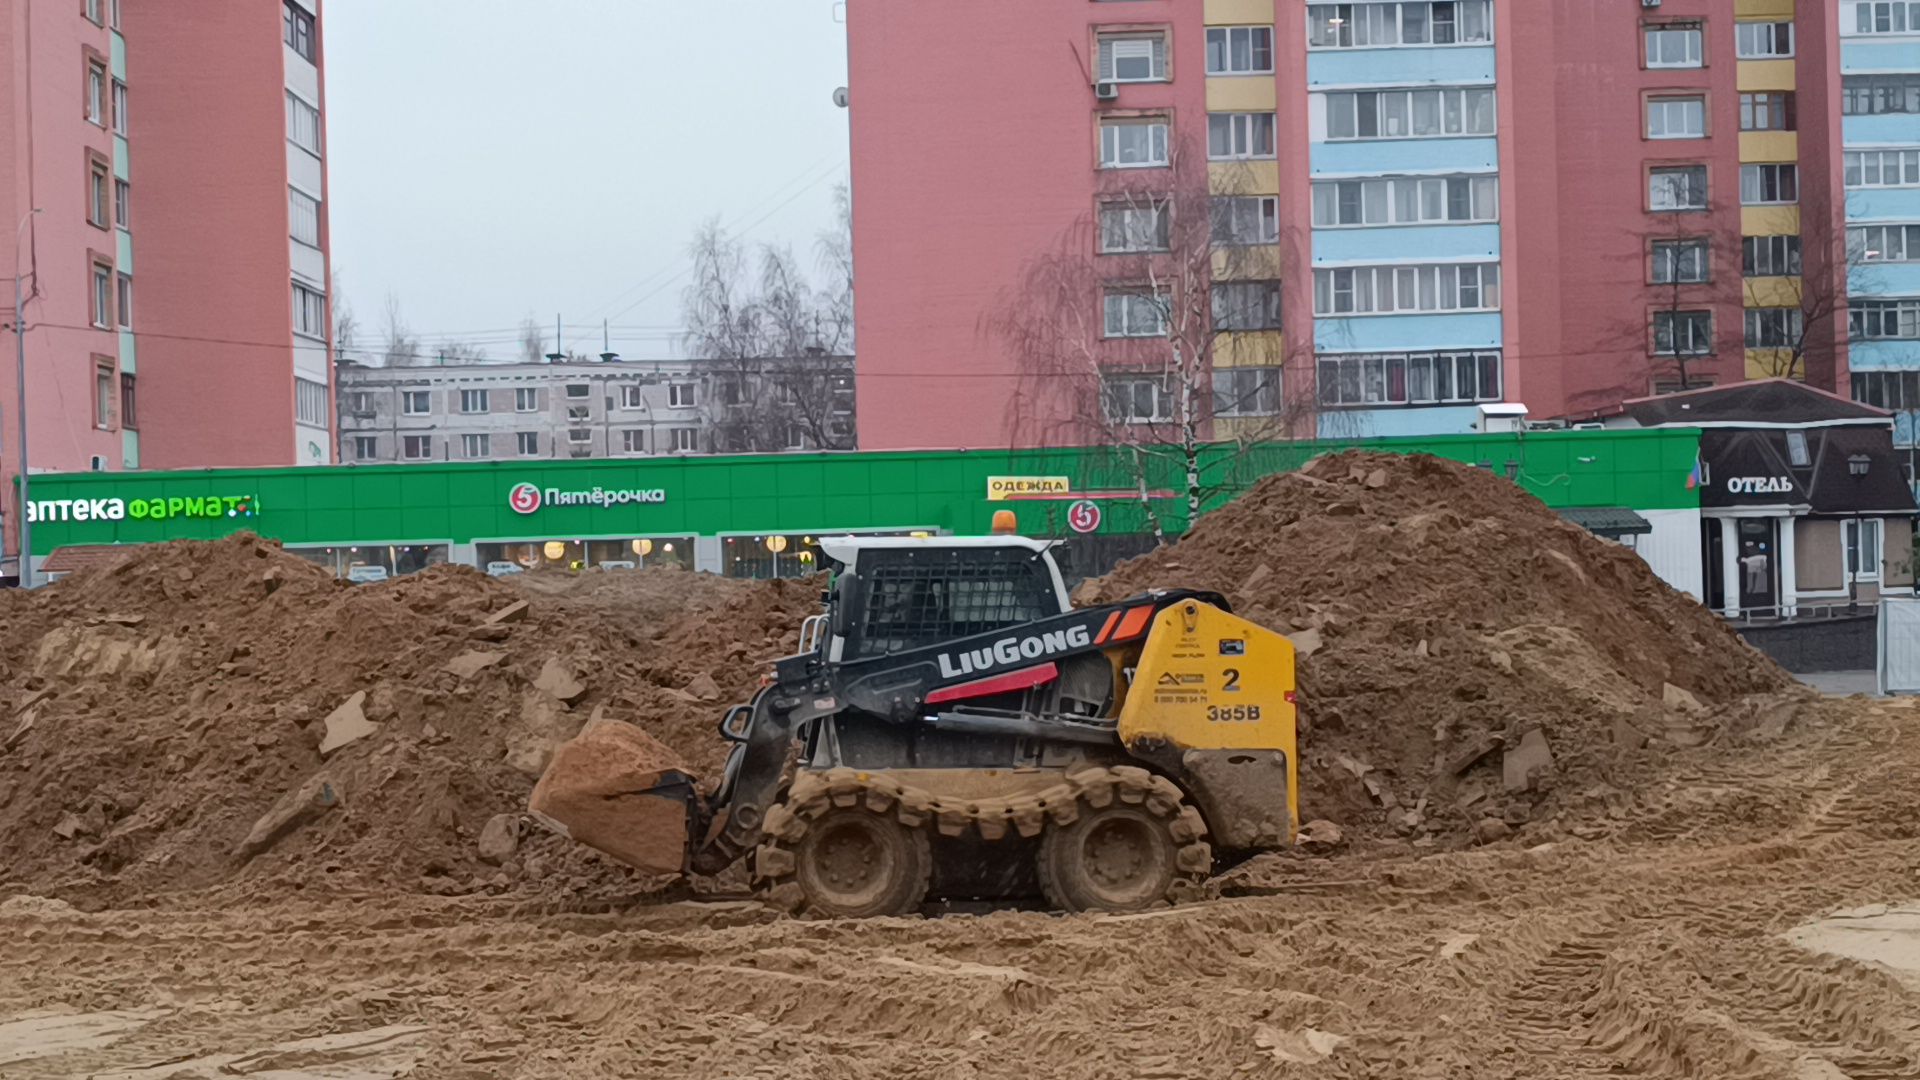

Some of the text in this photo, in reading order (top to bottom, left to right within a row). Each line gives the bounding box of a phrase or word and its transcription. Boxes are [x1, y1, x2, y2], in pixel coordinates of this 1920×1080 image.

[992, 481, 1064, 492] ОДЕЖДА
[1727, 476, 1793, 493] ОТЕЛЬ
[544, 487, 665, 508] Пятёрочка
[1222, 668, 1241, 691] 2
[1206, 704, 1261, 722] 385B
